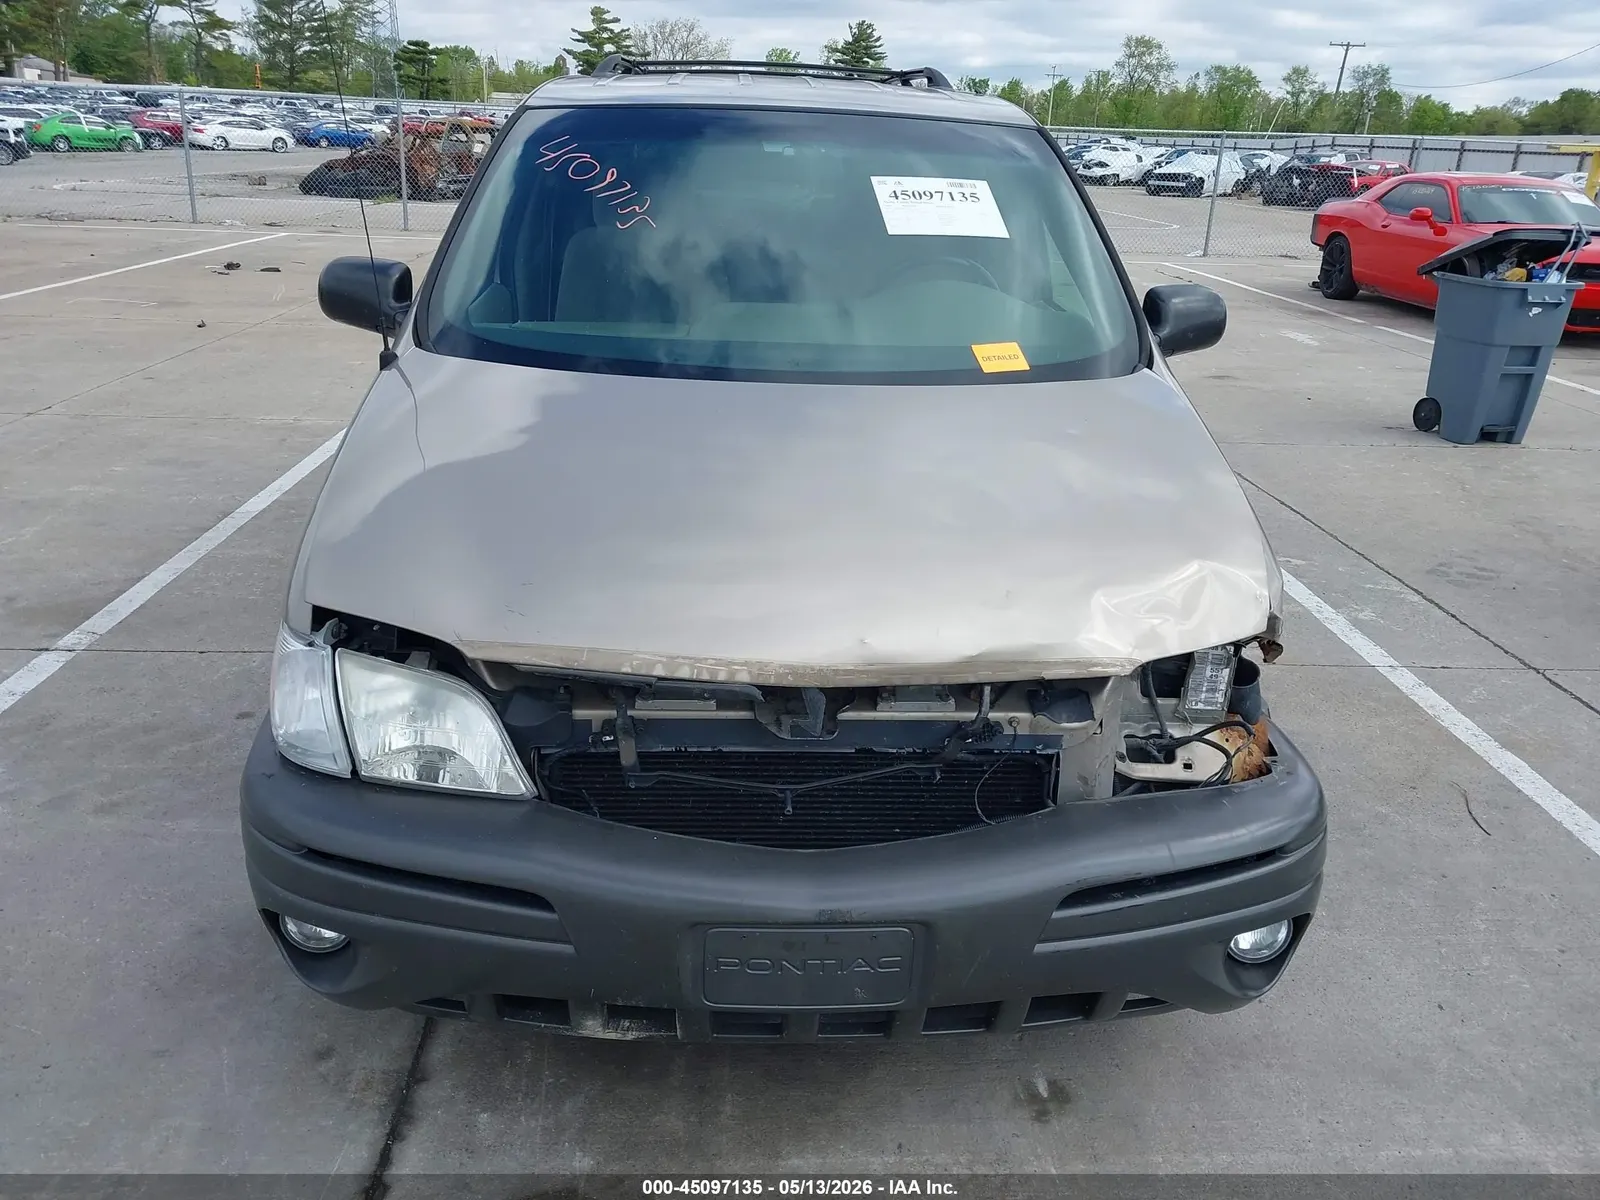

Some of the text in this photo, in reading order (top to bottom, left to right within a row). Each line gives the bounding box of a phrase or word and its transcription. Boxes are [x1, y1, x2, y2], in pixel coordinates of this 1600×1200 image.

[535, 135, 656, 229] 45097135
[888, 189, 981, 203] 45097135
[981, 354, 1020, 362] DETAILED
[715, 956, 903, 975] PONTIAC
